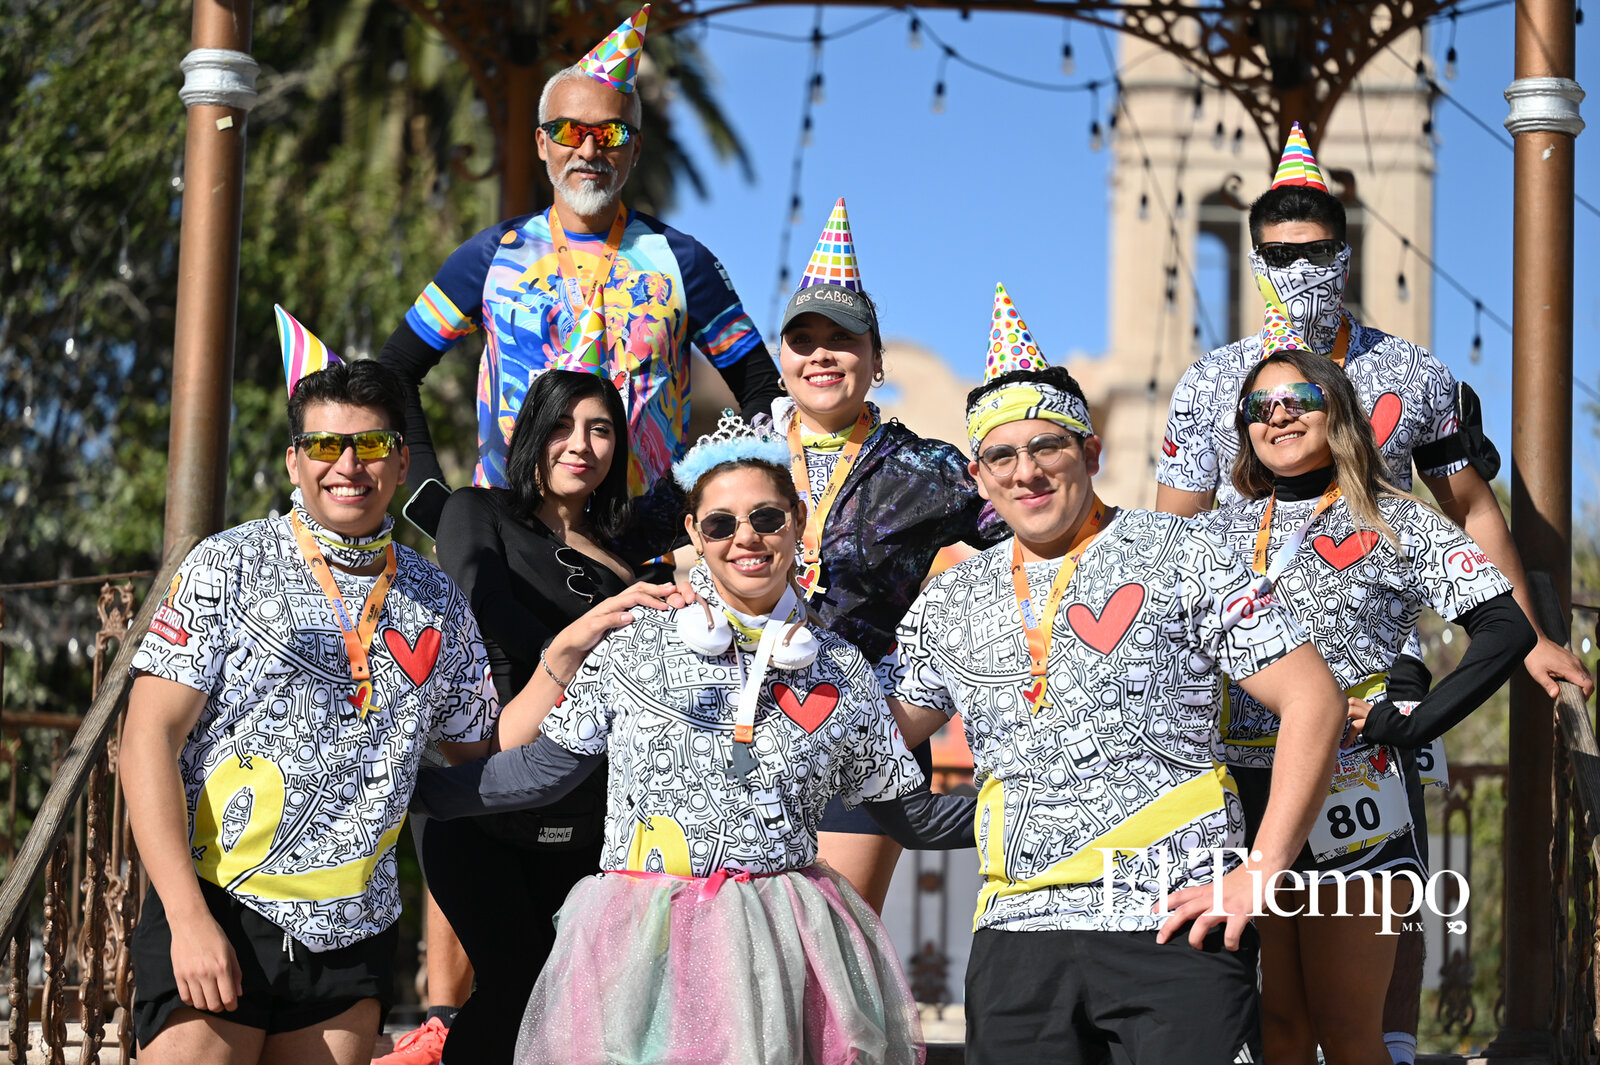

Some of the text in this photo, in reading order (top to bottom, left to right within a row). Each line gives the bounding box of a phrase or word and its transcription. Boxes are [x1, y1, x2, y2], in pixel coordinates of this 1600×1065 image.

[795, 289, 854, 307] LOS CABOS
[289, 595, 363, 611] SALVEOS
[972, 584, 1048, 627] SALVEOS
[156, 605, 182, 631] EDRO
[1326, 797, 1381, 839] 80
